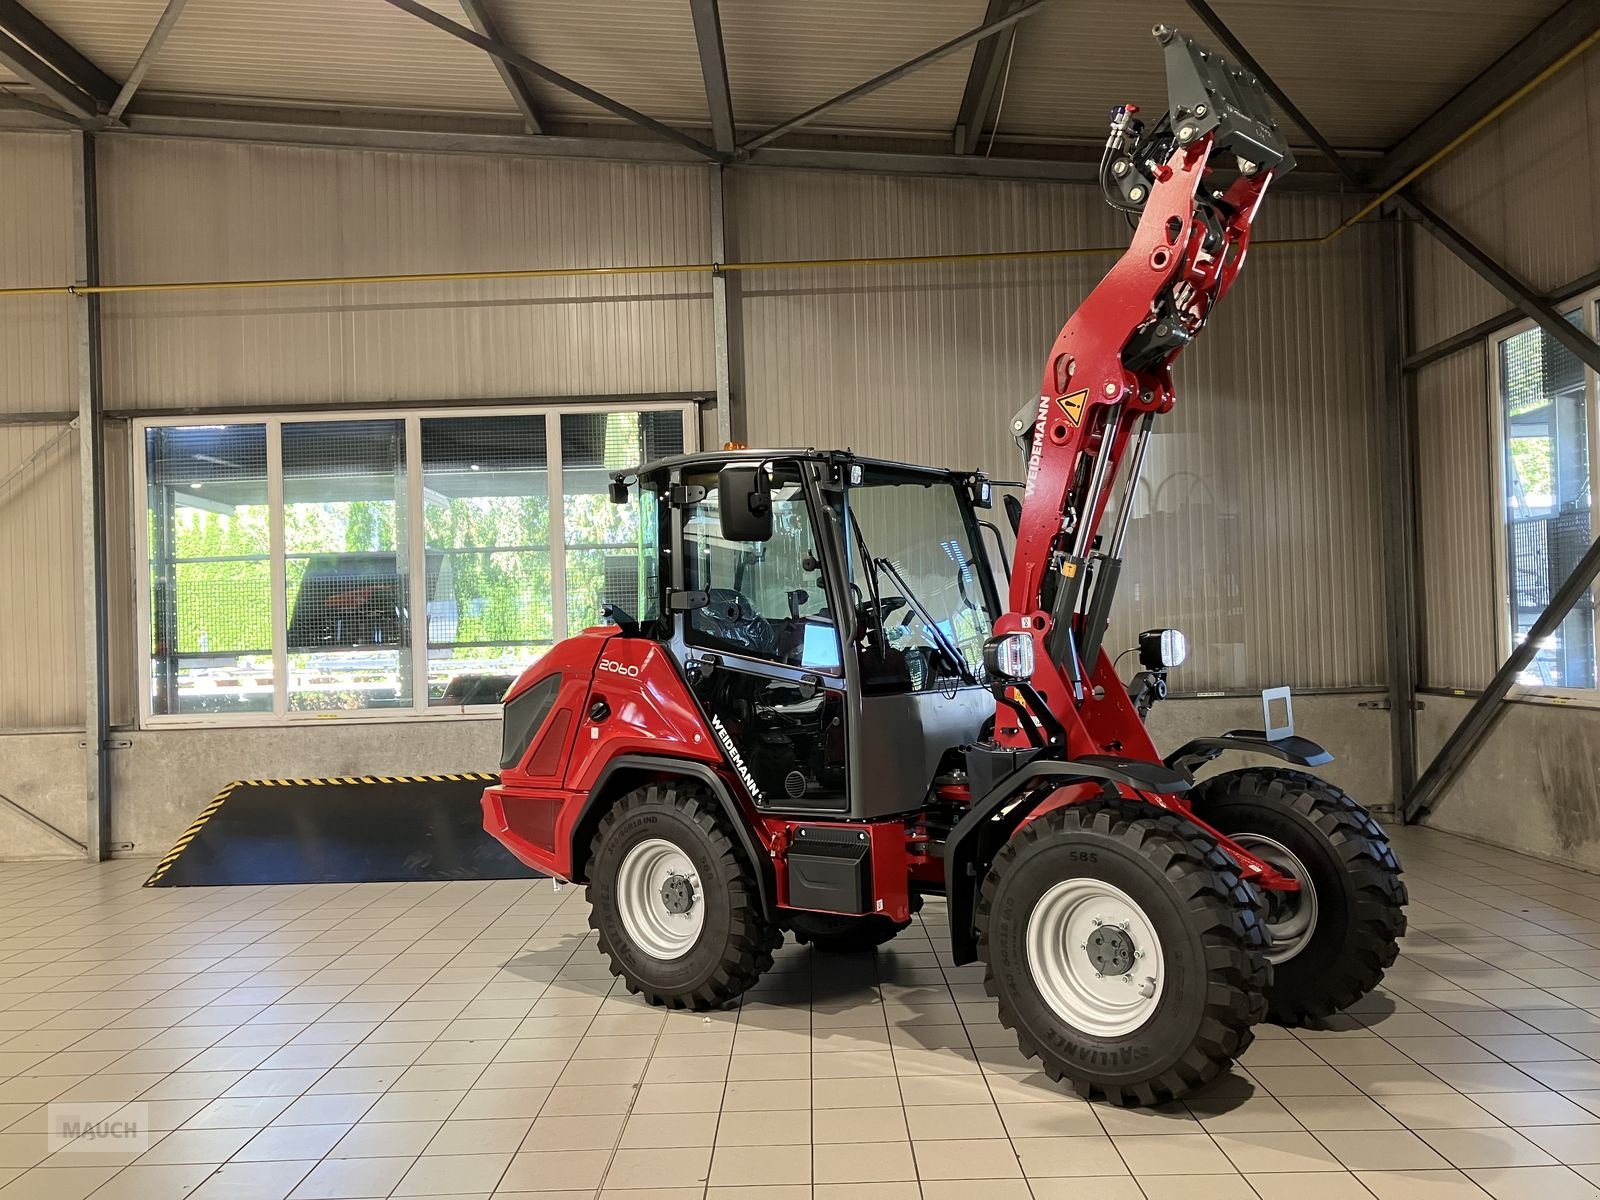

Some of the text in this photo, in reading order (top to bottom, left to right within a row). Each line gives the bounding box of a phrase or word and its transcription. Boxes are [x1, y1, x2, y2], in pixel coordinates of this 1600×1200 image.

[1025, 395, 1050, 497] WEIDEMANN
[599, 658, 639, 677] 2060
[711, 714, 760, 797] WEIDEMANN
[1069, 851, 1098, 864] 585
[1045, 1027, 1133, 1067] ALLIANCE
